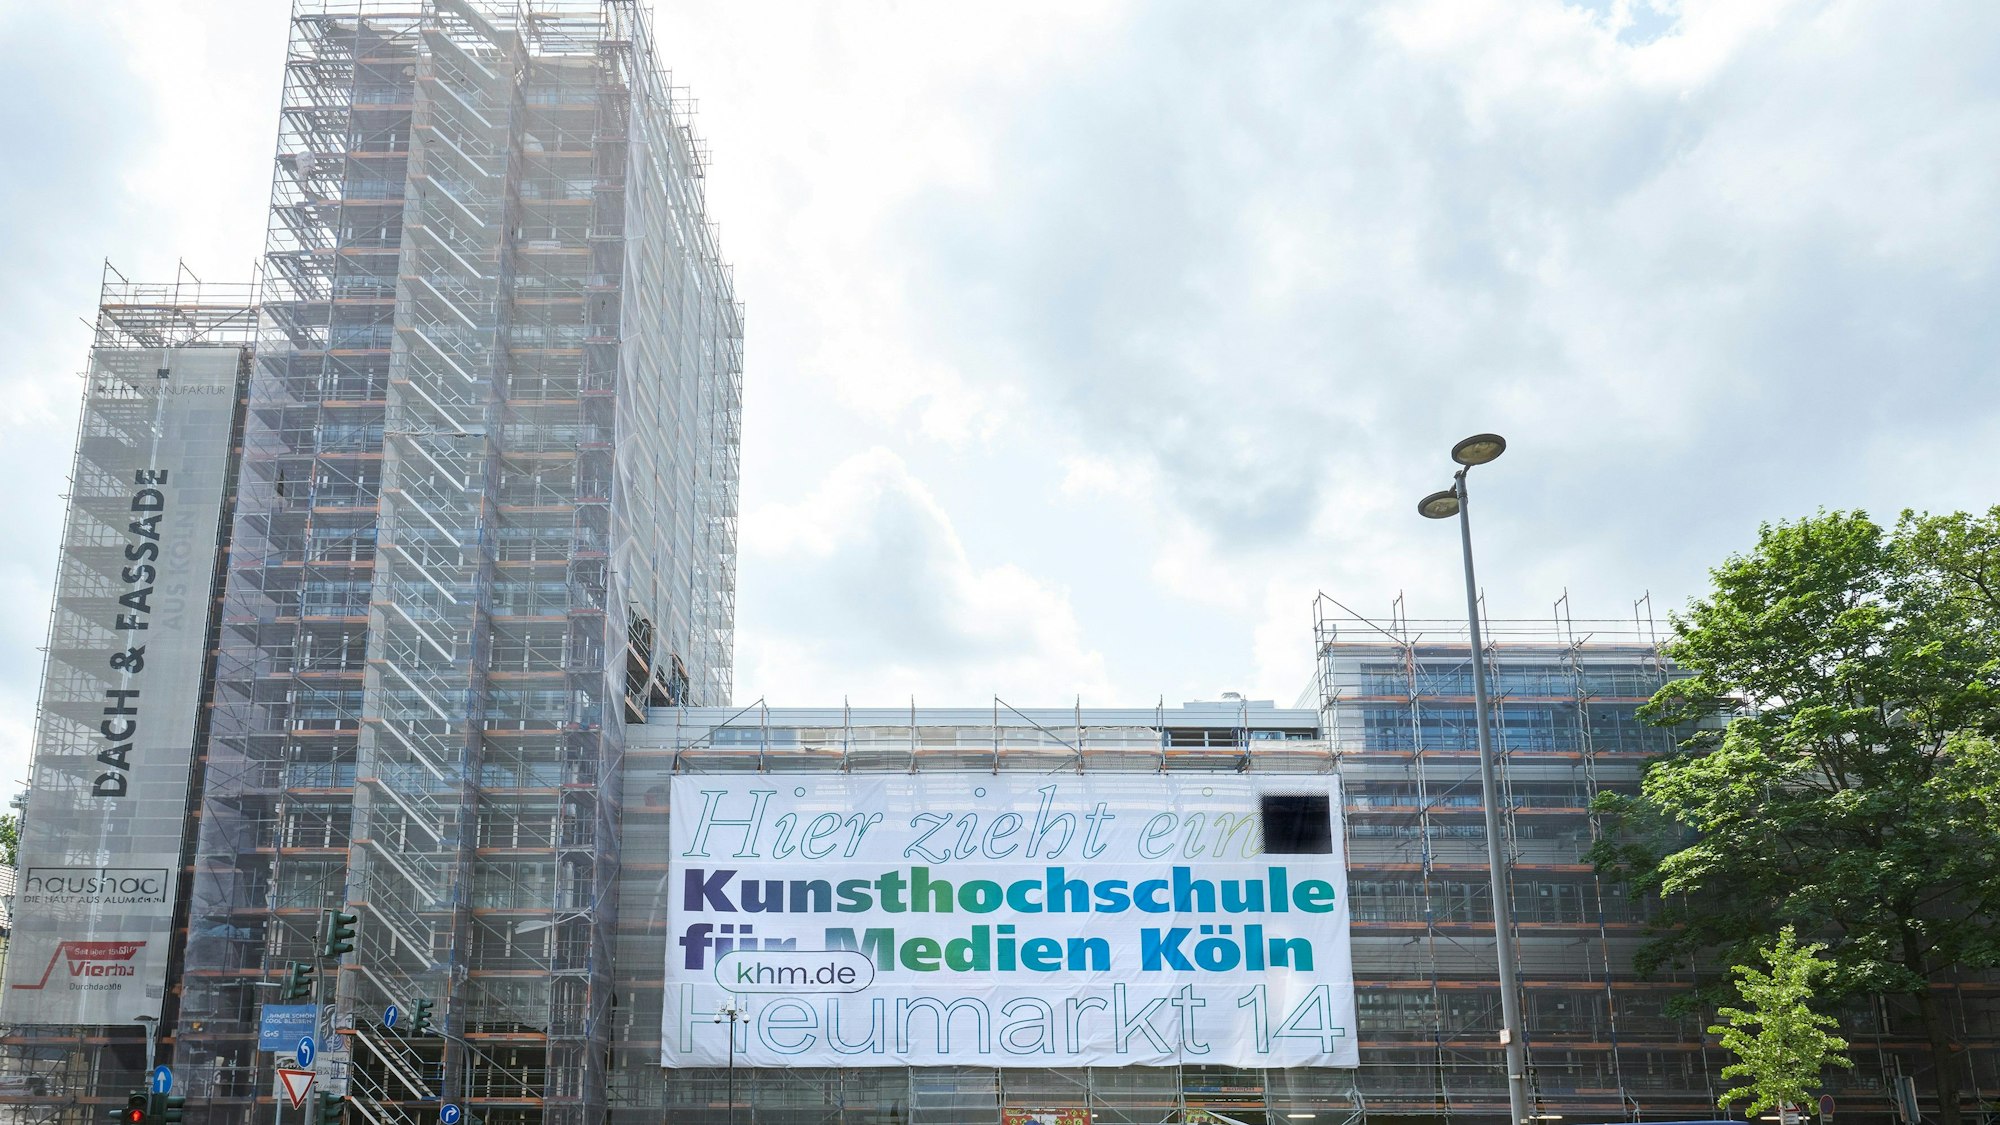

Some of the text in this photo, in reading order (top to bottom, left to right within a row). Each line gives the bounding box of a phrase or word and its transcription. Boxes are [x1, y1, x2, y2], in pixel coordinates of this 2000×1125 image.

[92, 469, 168, 797] DACH & FASSADE
[682, 784, 1267, 864] Hier zieht ein
[683, 866, 1336, 914] Kunsthochschule
[737, 962, 857, 985] khm.de
[825, 924, 1111, 972] Medien
[1140, 924, 1314, 972] Köln
[679, 983, 1346, 1055] Heumarkt 14
